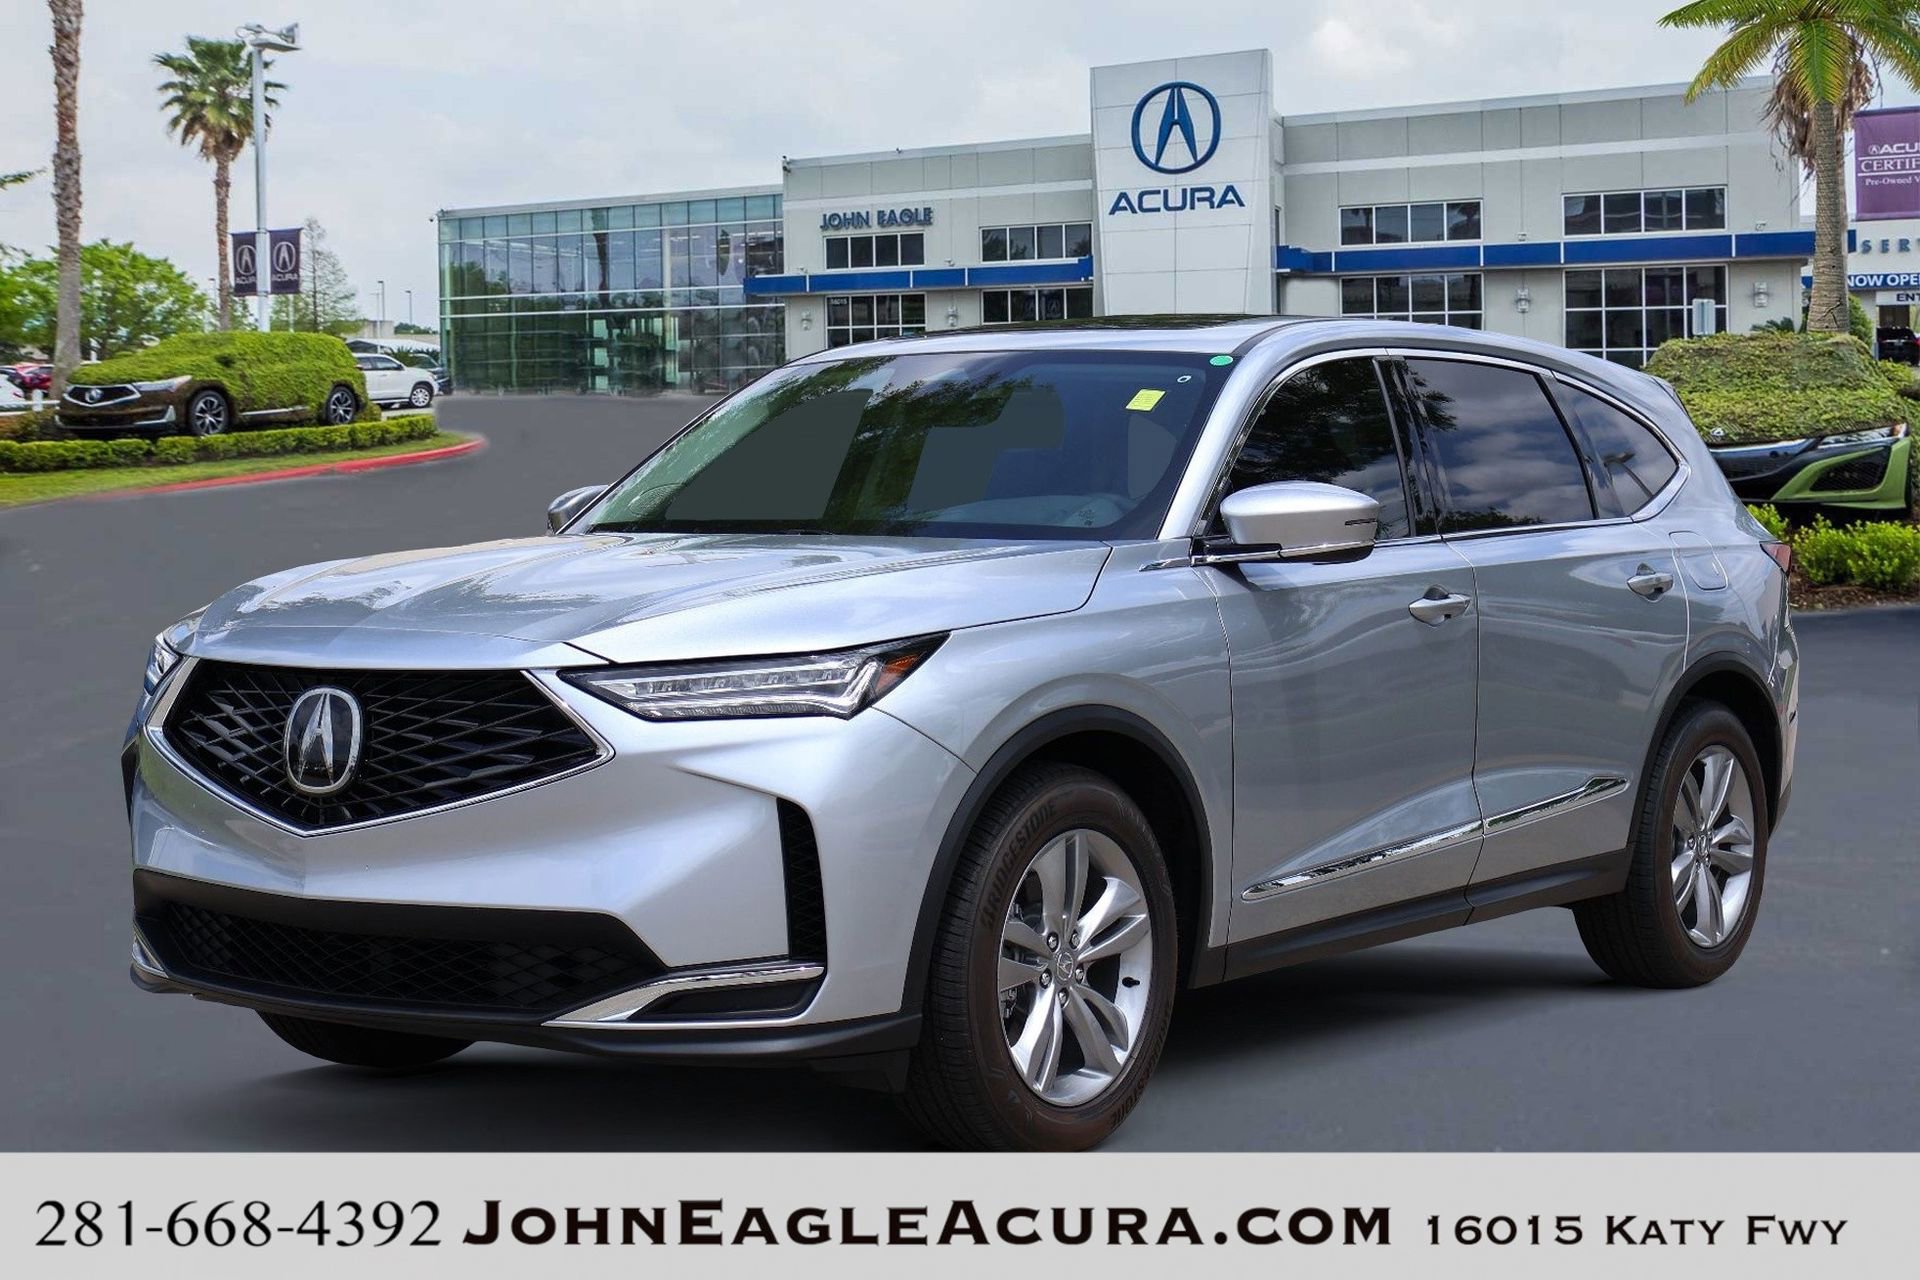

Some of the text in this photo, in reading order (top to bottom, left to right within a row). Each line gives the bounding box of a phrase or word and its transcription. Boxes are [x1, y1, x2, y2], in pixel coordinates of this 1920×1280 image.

[1880, 143, 1920, 154] ACU
[1108, 184, 1246, 216] ACURA
[820, 207, 933, 231] JOHN EAGLE
[235, 275, 257, 284] ACUR
[1848, 273, 1920, 287] NOW OPE
[981, 802, 1056, 929] BRIDGESTONE
